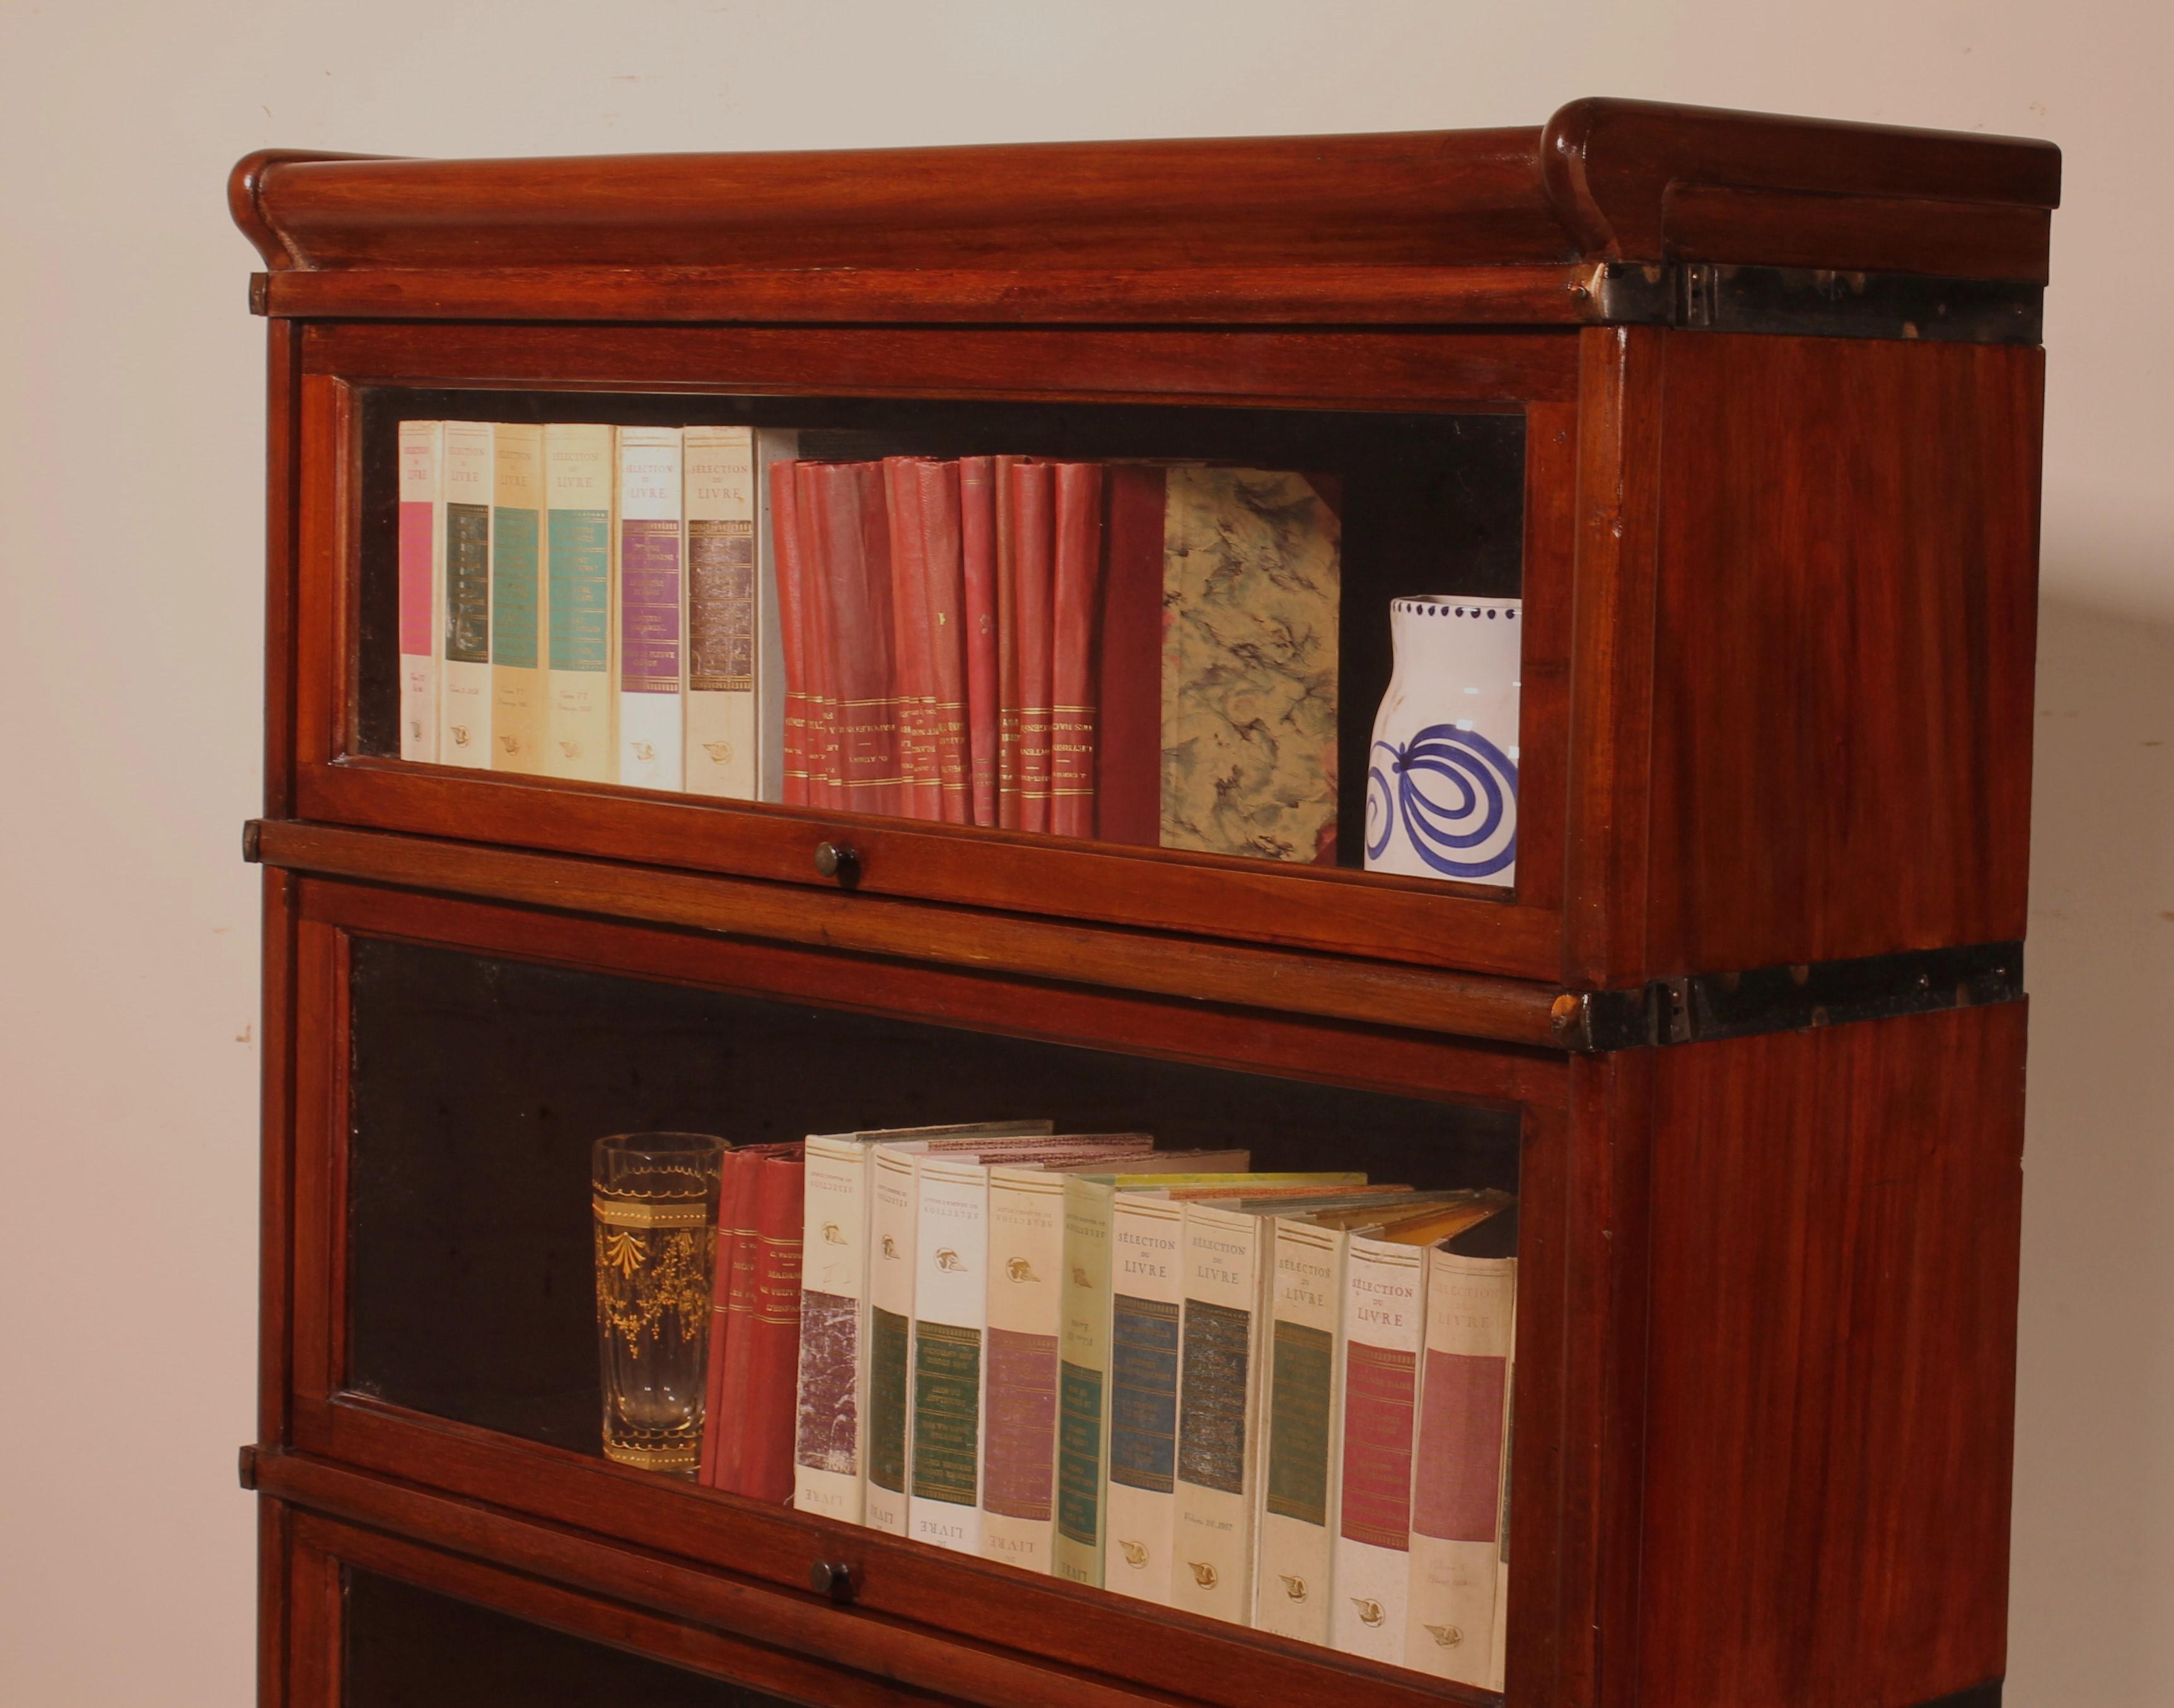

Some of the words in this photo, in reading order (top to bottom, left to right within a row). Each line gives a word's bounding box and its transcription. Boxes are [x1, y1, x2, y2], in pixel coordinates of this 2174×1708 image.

[557, 477, 593, 488] LIVRE
[631, 488, 666, 499] LIVRE
[698, 488, 740, 499] LIVRE
[1117, 1231, 1176, 1250] SÉLECTION
[1192, 1236, 1247, 1256] SÉLECTION
[1124, 1260, 1166, 1278] LIVRE
[1197, 1265, 1239, 1285] LIVRE
[1278, 1258, 1332, 1279] SÉLECTION
[1352, 1277, 1414, 1298] SÉLECTION
[1286, 1287, 1324, 1307] LIVRE
[1373, 1298, 1383, 1306] DU
[1357, 1307, 1404, 1327] LIVRE
[1438, 1311, 1490, 1329] LIVRE
[805, 1489, 843, 1506] LIVRE
[920, 1520, 963, 1538] LIVRE
[989, 1535, 1034, 1553] LIVRE
